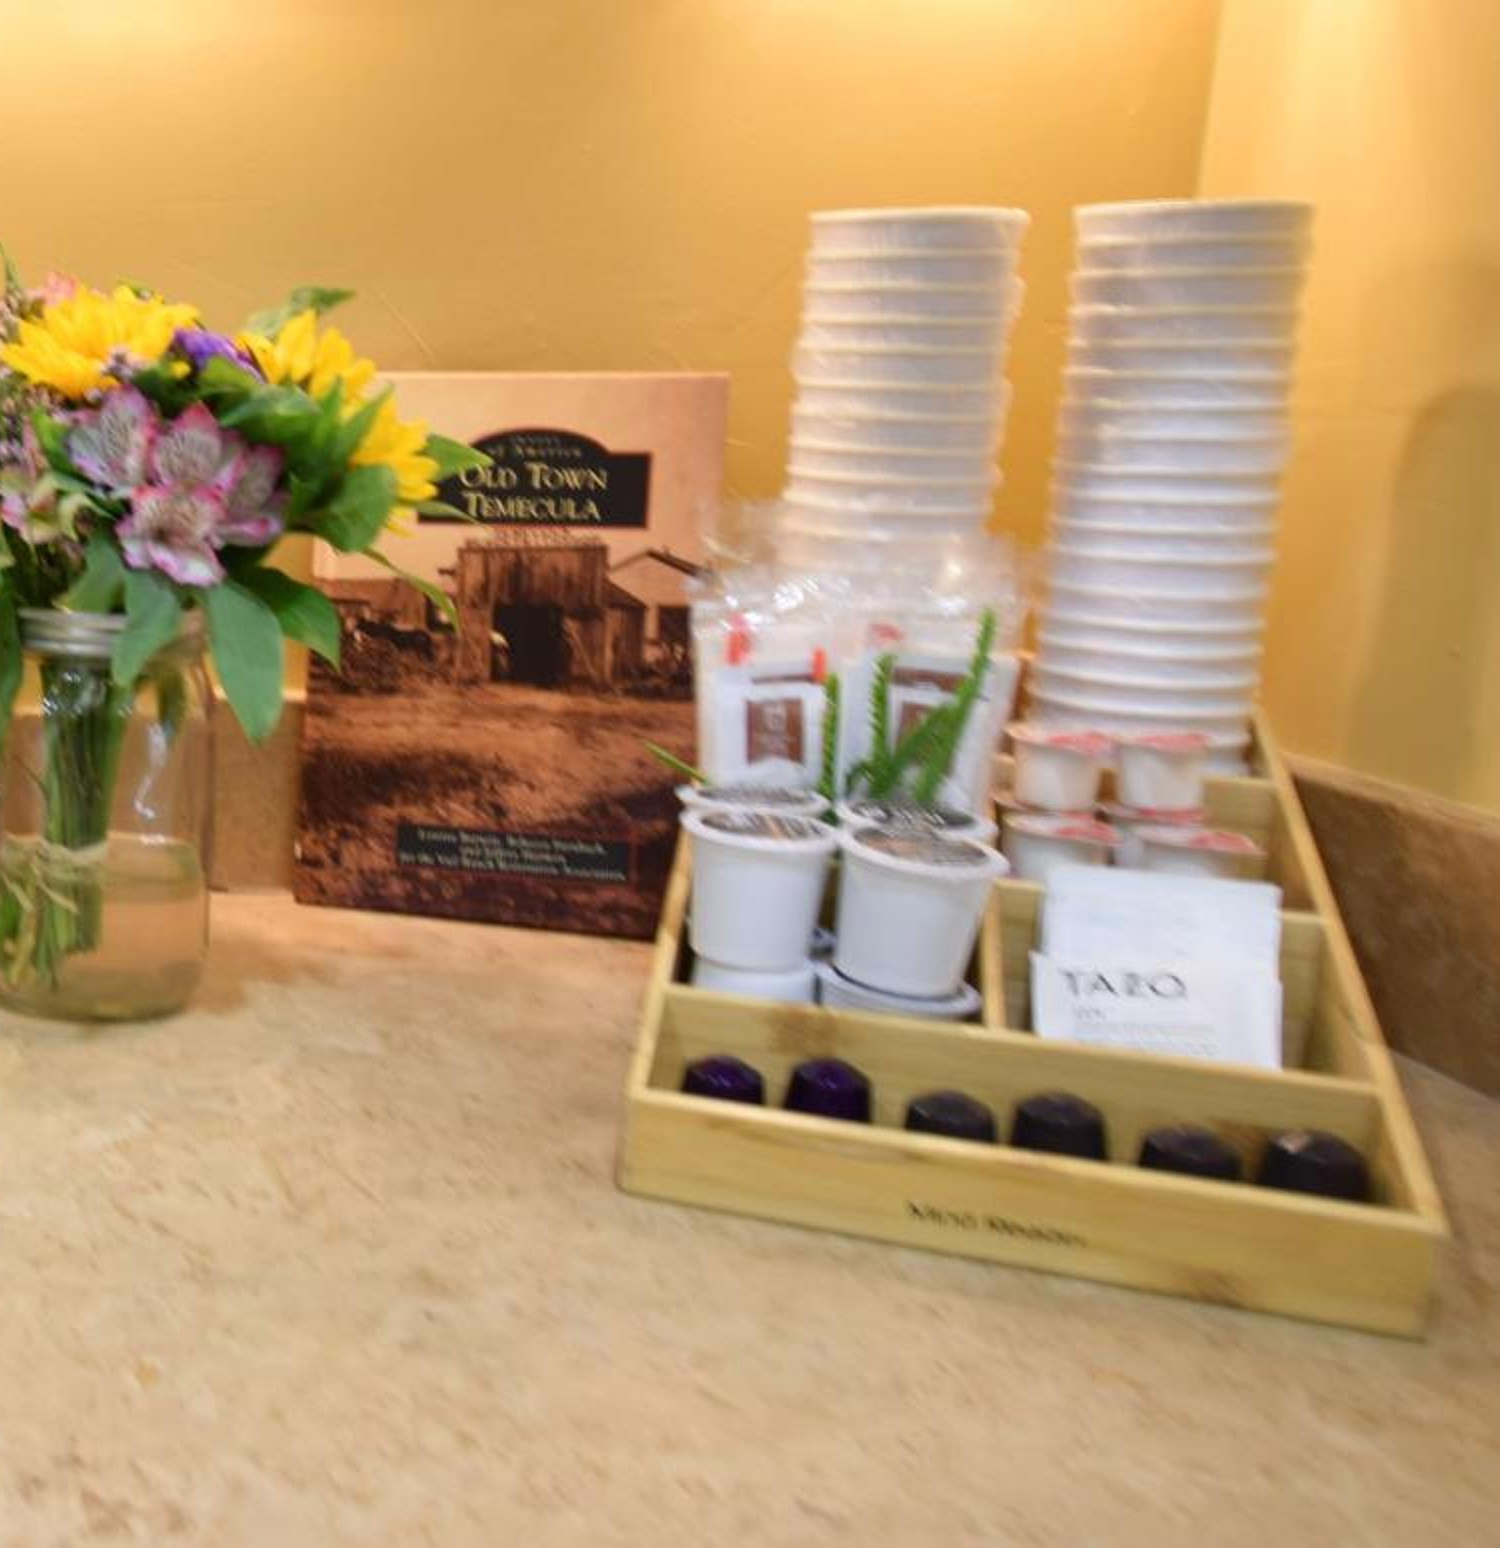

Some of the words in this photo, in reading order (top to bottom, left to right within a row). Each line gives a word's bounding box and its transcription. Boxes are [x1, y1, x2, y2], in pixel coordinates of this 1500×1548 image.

[459, 463, 518, 490] OLD
[524, 461, 609, 491] TOWN
[460, 490, 602, 521] TEMECULA
